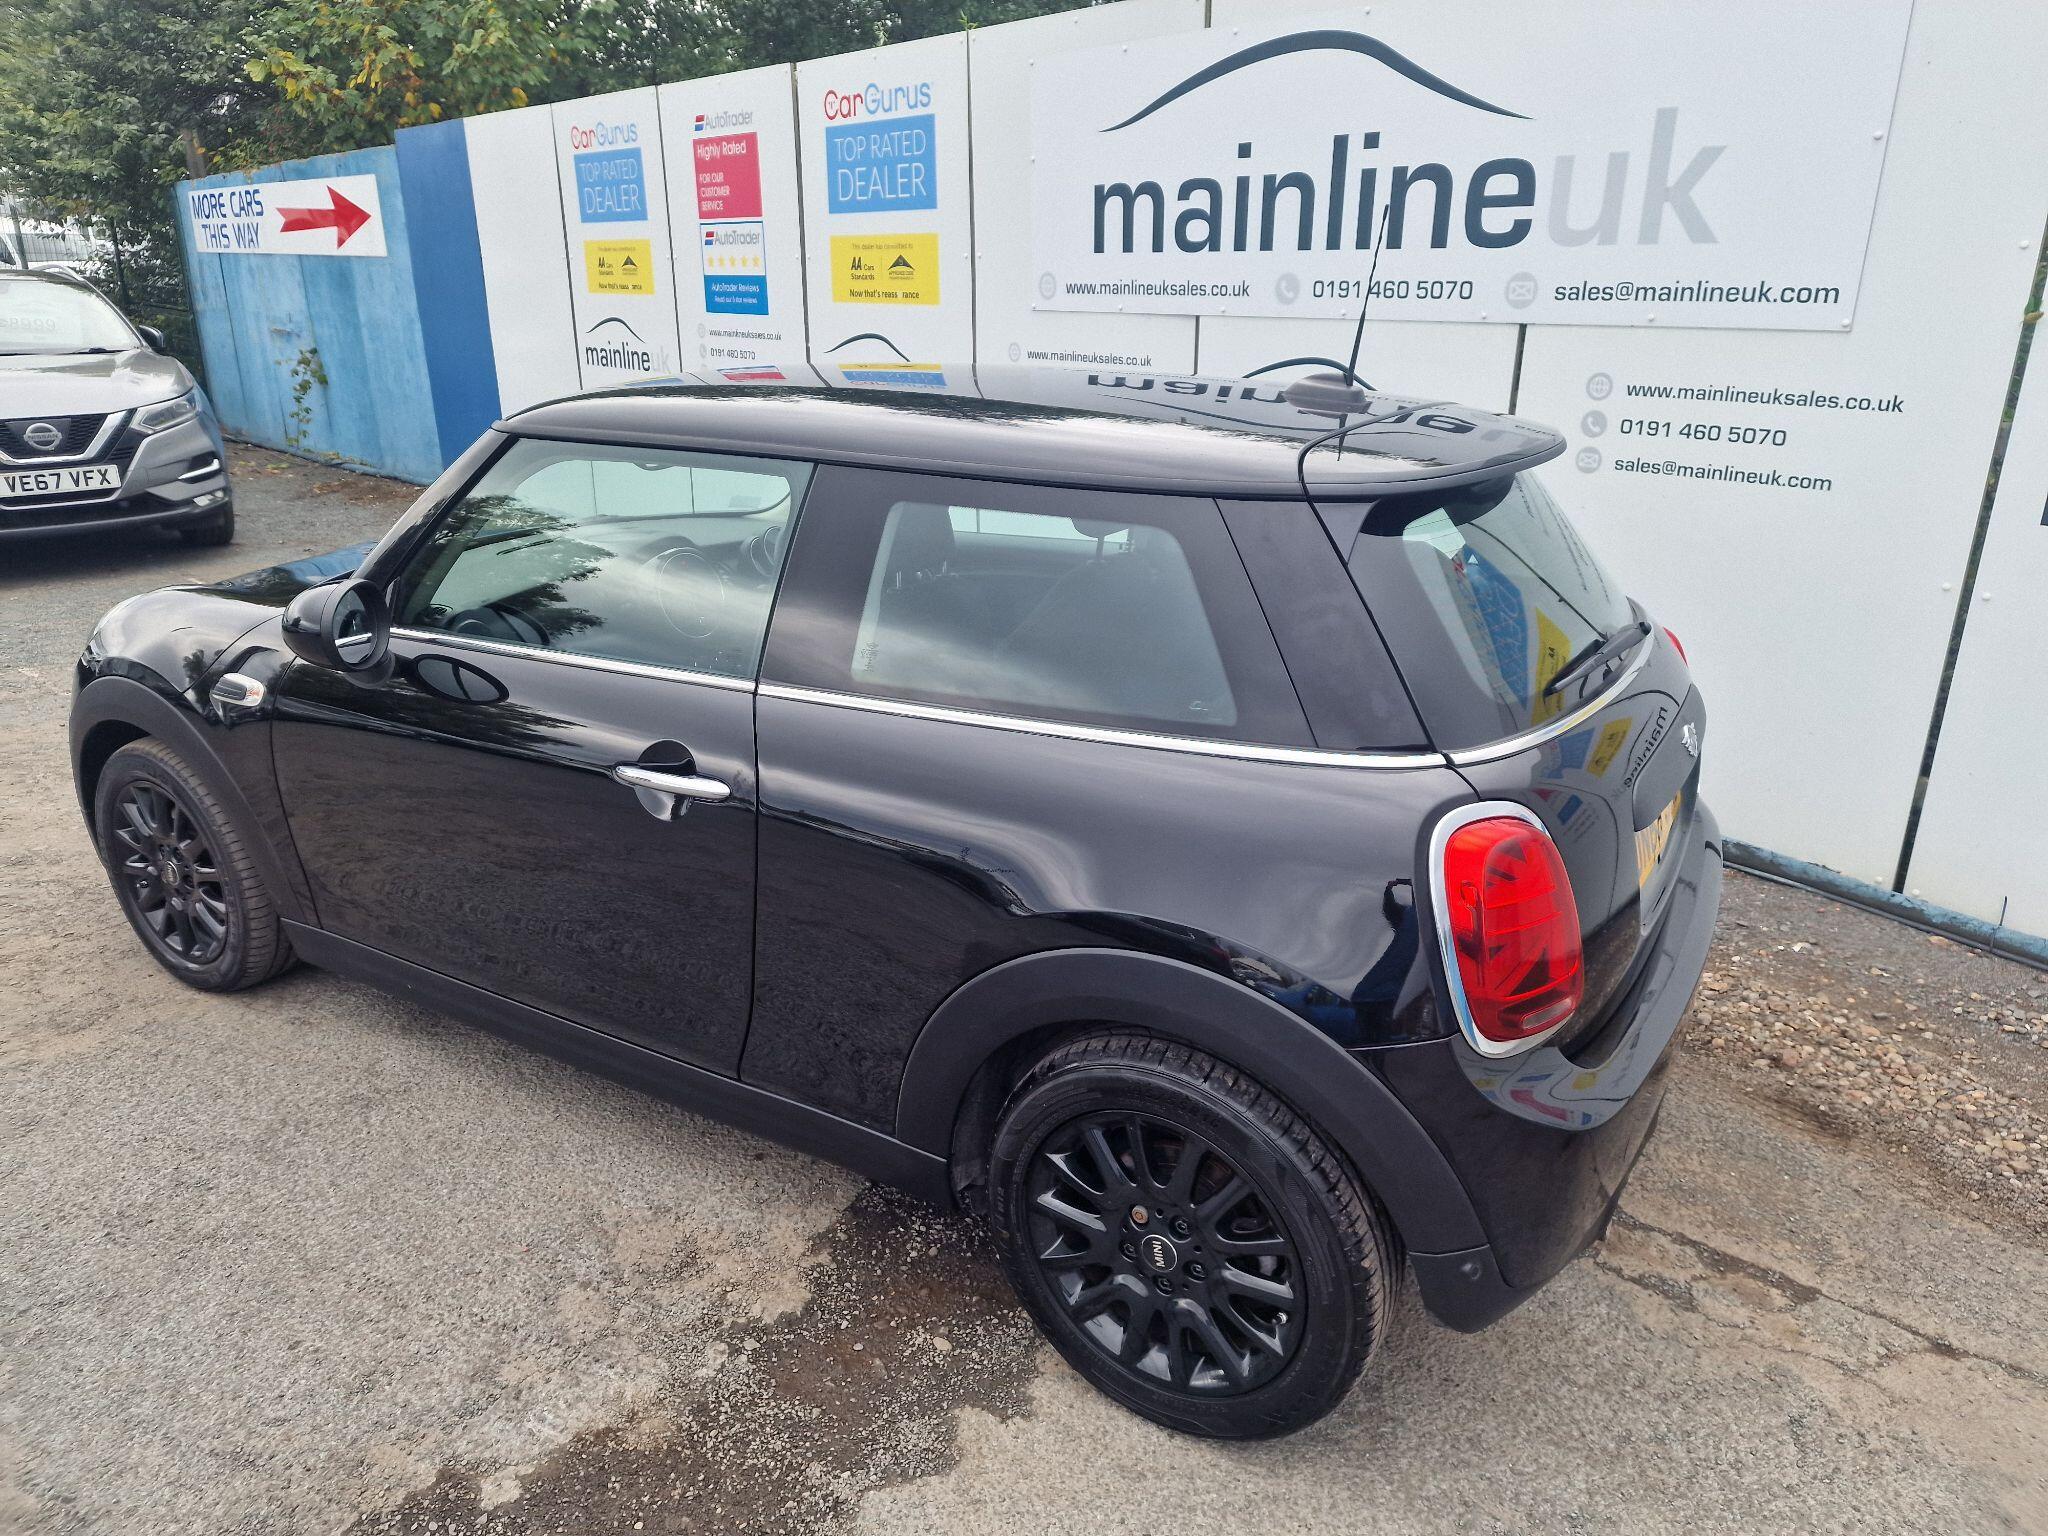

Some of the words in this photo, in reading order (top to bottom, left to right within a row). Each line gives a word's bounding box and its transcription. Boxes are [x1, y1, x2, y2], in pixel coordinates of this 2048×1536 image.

[824, 82, 932, 120] CarGurus
[705, 109, 754, 130] AutoTrader
[571, 122, 638, 149] CarGurus
[833, 136, 867, 162] TOP
[871, 129, 926, 159] RATED
[697, 144, 721, 160] Highly
[722, 140, 747, 155] Rated
[579, 162, 600, 182] TOP
[602, 158, 638, 179] RATED
[838, 162, 927, 201] DEALER
[191, 192, 227, 220] MORE
[229, 188, 264, 218] CARS
[584, 184, 641, 213] DEALER
[201, 223, 231, 249] THIS
[232, 222, 261, 249] WAY
[714, 230, 760, 246] AutoTrader
[851, 256, 862, 271] AA
[849, 289, 864, 298] Now
[1065, 279, 1251, 298] www.mainlineuksales.co.uk
[1312, 279, 1362, 299] 0191
[1368, 280, 1410, 300] 460
[1415, 280, 1474, 300] 5070
[1554, 280, 1840, 305] sales@mainlineuk.com
[1027, 348, 1153, 368] www.mainlineuksales.co.uk
[1626, 380, 1905, 414] www.mainlineuksales.co.uk
[1620, 418, 1673, 439] 0191
[1678, 421, 1722, 443] 460
[1728, 425, 1787, 447] 5070
[4, 473, 62, 494] VE67
[69, 469, 112, 488] VFX
[1614, 457, 1833, 493] sales@mainlineuk.com
[1152, 1240, 1166, 1268] MINI
